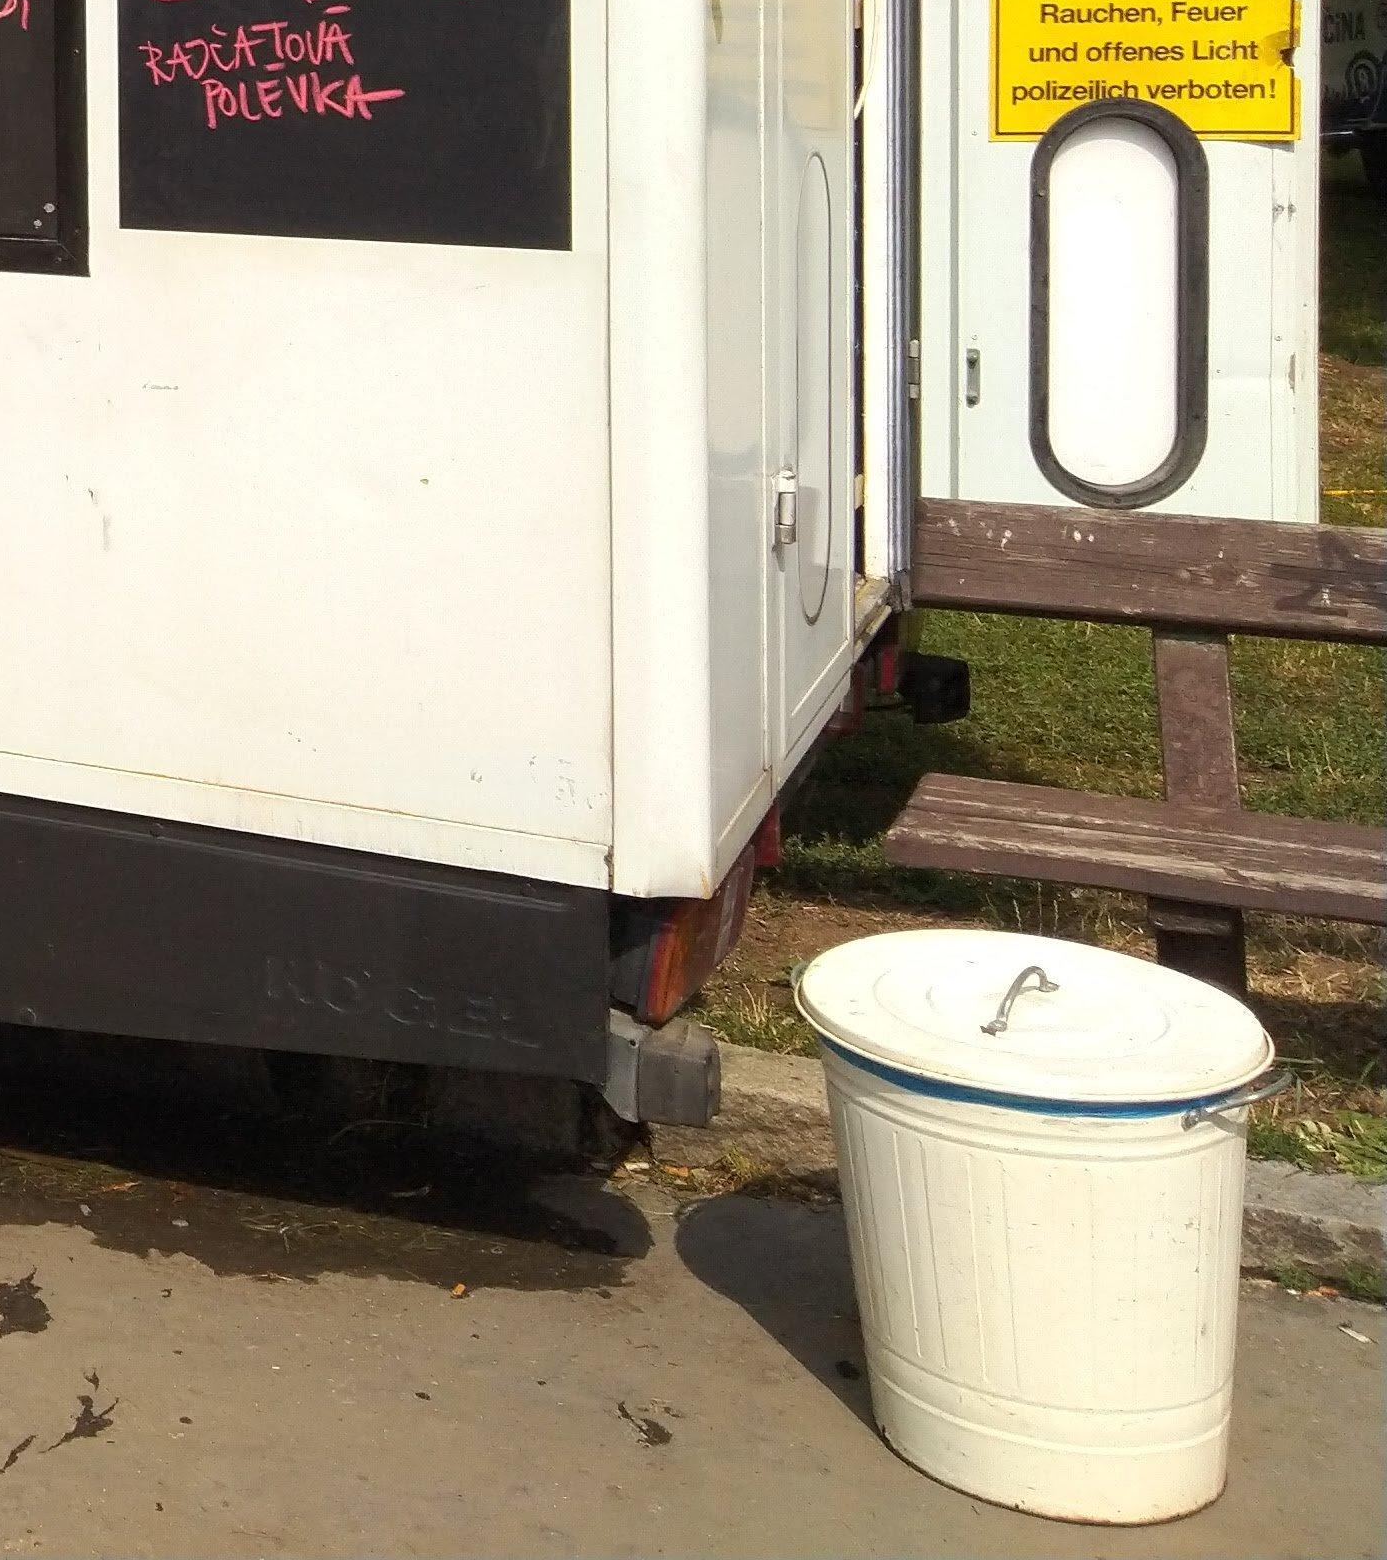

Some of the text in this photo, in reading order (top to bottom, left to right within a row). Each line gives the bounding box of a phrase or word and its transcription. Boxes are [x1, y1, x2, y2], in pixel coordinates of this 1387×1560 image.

[1040, 1, 1248, 26] Rauchen, Feuer
[1029, 39, 1258, 62] und offenes Licht
[1012, 78, 1277, 106] polizeilich verboten!
